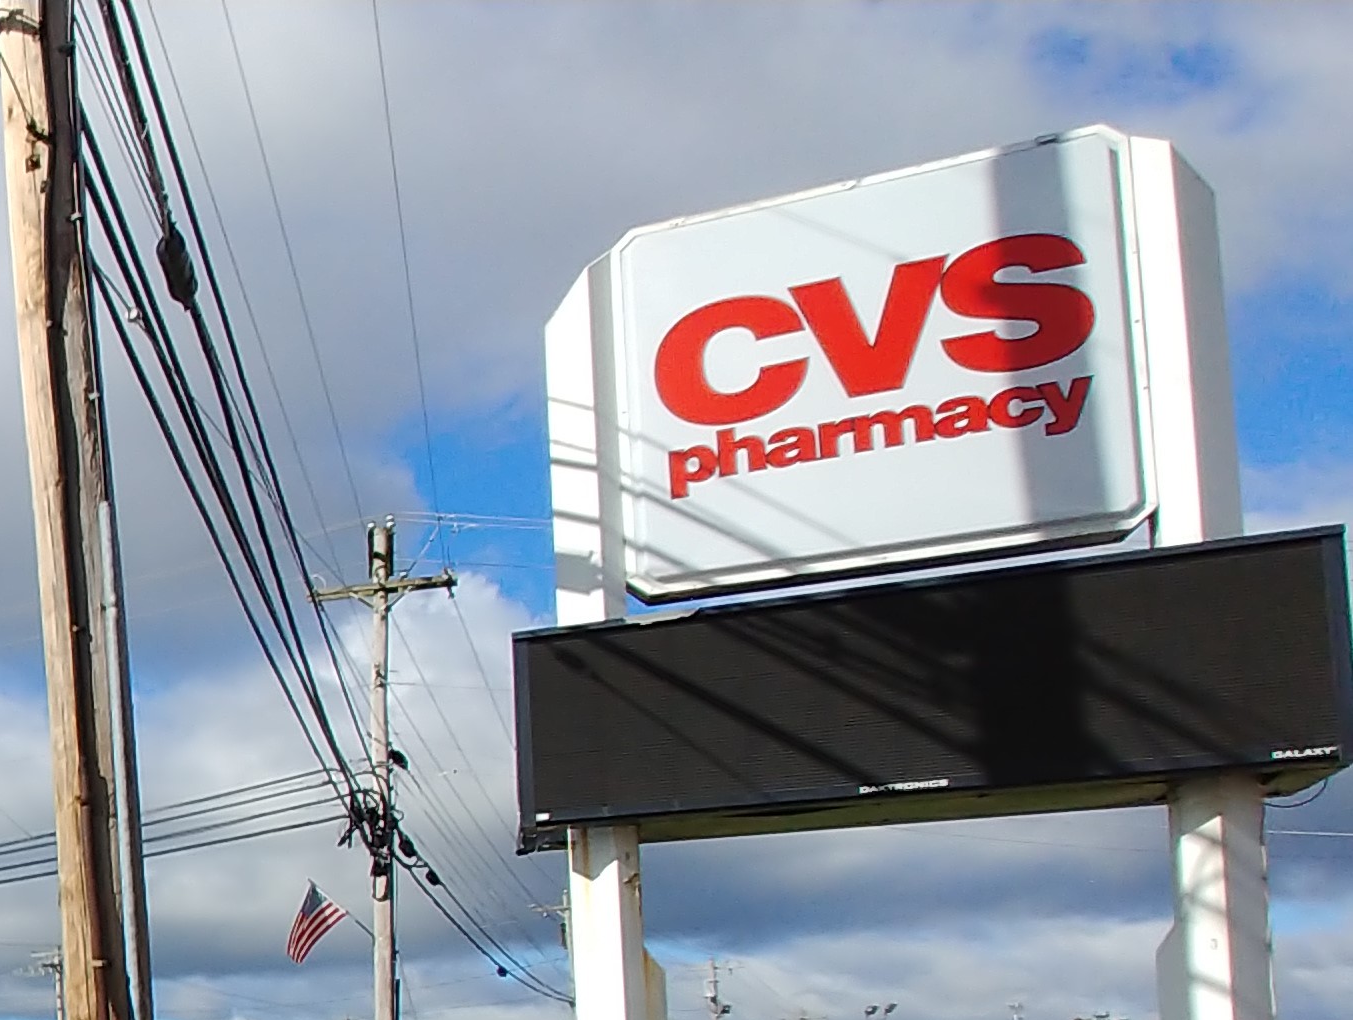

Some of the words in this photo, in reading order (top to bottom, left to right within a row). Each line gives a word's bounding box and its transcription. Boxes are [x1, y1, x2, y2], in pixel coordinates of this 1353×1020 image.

[654, 233, 1095, 426] CVS
[668, 375, 1093, 499] pharmacy
[1272, 746, 1337, 759] GALAXY
